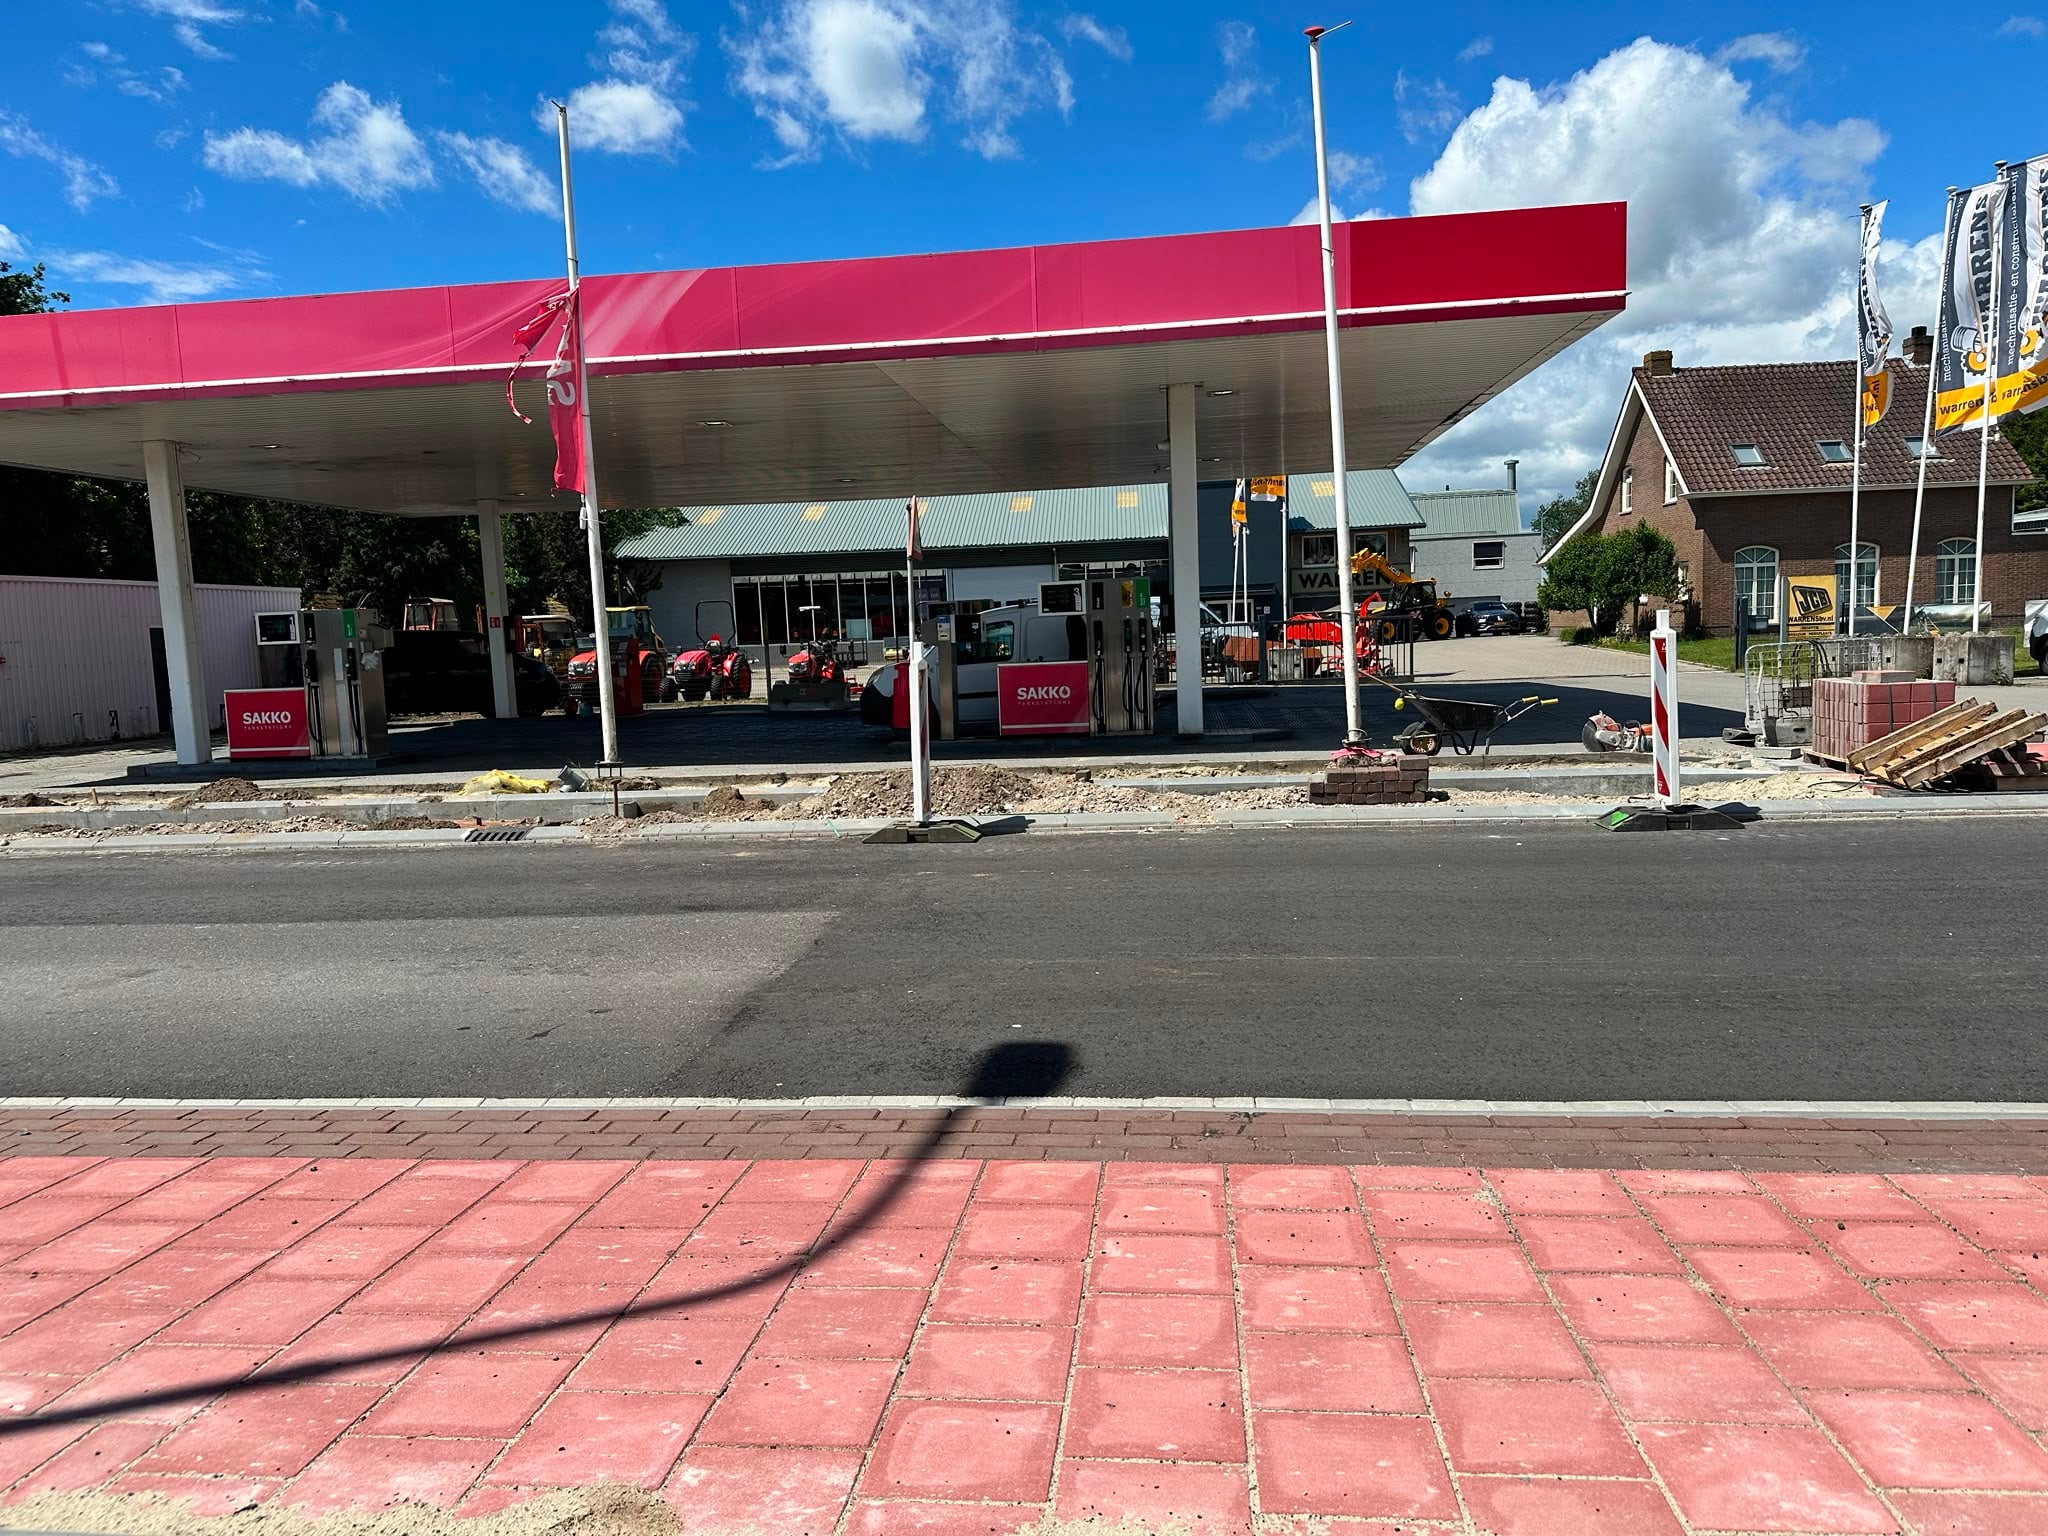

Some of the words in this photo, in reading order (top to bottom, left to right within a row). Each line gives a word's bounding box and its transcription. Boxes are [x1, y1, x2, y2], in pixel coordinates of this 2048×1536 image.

[1298, 568, 1404, 588] WAREN
[1797, 588, 1830, 613] JCB
[1017, 686, 1071, 700] SAKKO
[243, 711, 291, 724] SAKKO
